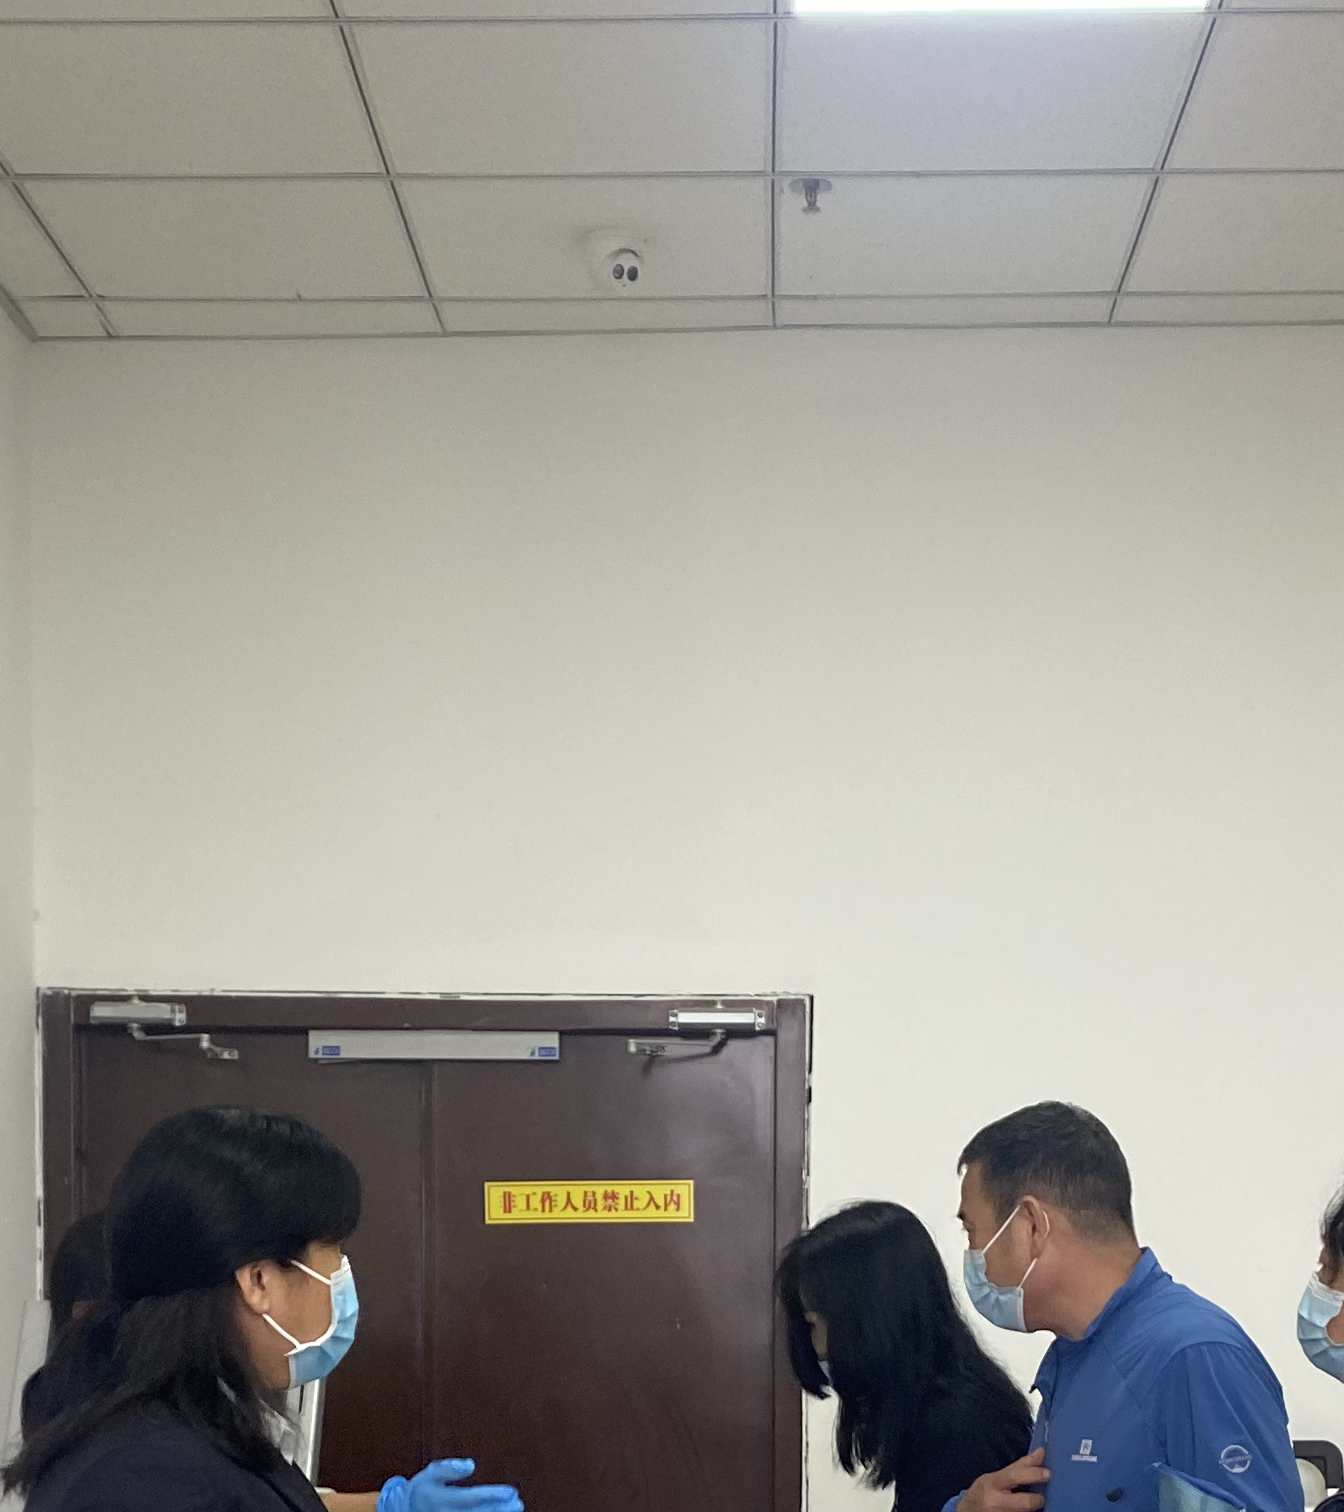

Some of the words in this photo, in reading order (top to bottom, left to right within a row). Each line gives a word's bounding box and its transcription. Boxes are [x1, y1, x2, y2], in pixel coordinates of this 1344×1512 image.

[499, 1189, 682, 1215] 非工作人员禁止入内
